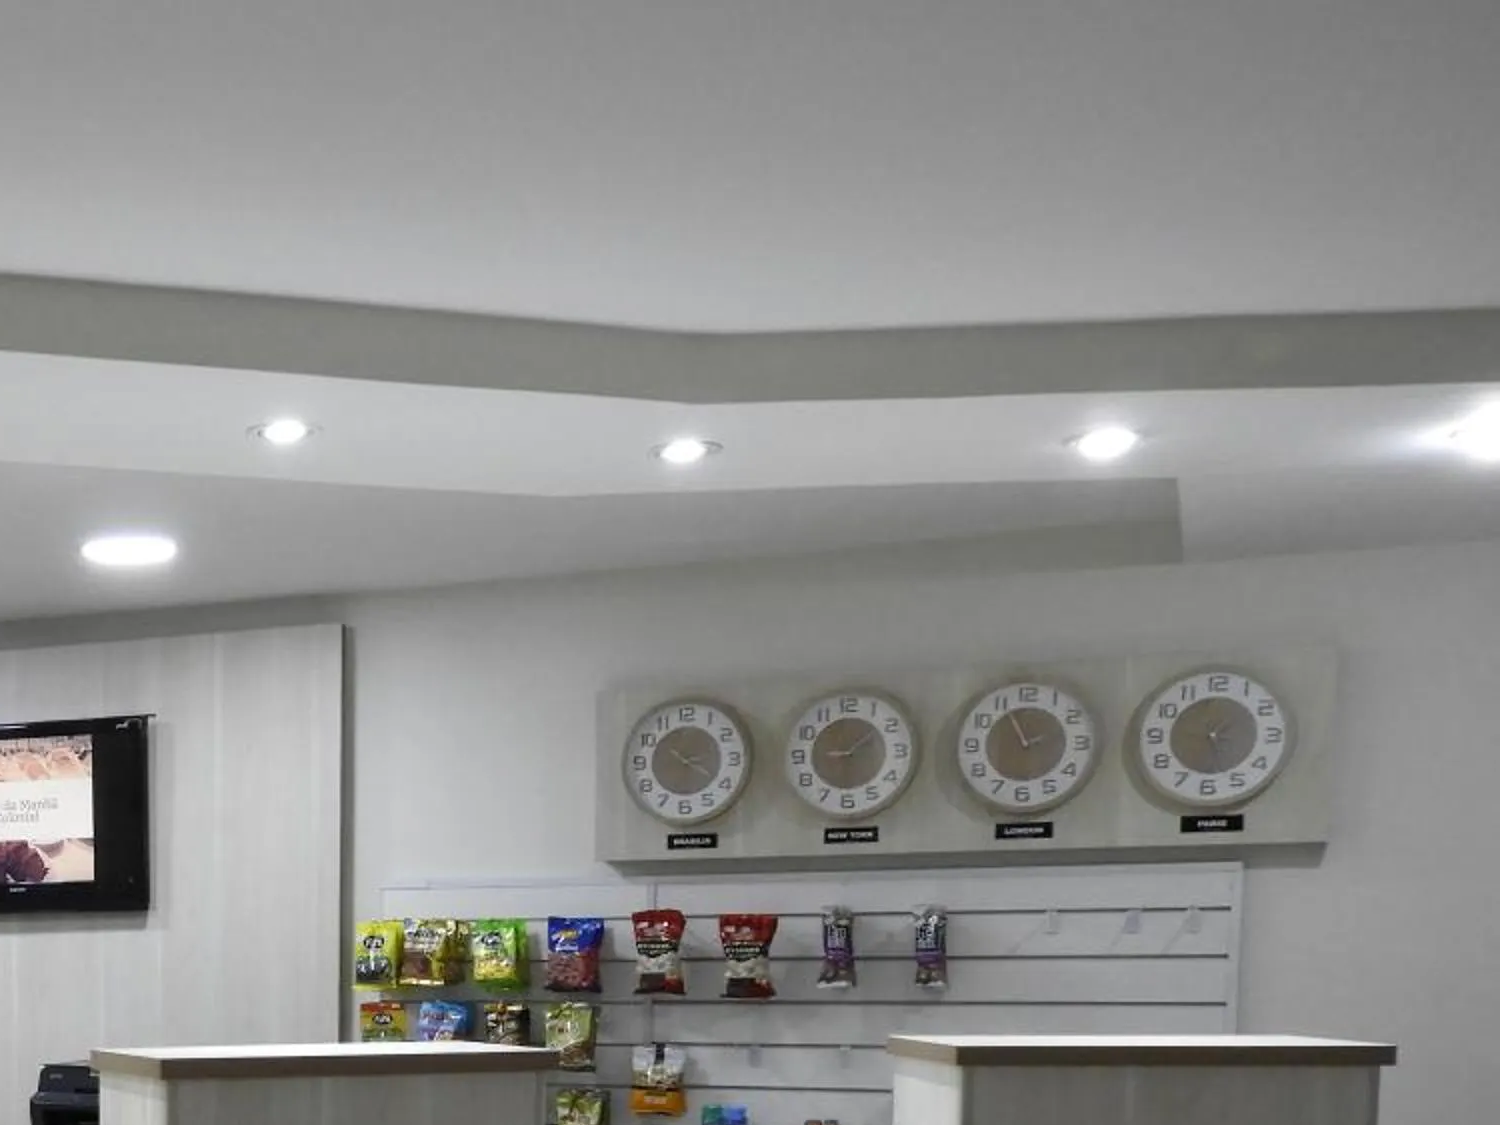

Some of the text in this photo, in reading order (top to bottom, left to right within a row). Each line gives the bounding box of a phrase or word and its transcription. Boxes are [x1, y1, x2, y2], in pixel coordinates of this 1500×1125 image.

[1208, 676, 1229, 692] 12
[1019, 687, 1038, 702] 12
[1181, 685, 1196, 700] 11
[840, 698, 859, 713] 12
[995, 697, 1007, 710] 11
[1159, 703, 1177, 718] 10
[1258, 700, 1274, 716] 2
[680, 707, 695, 722] 12
[818, 708, 829, 721] 11
[975, 713, 992, 728] 10
[1066, 709, 1080, 724] 2
[658, 716, 669, 730] 11
[884, 718, 898, 732] 2
[721, 727, 733, 742] 2
[800, 725, 815, 740] 10
[1147, 728, 1163, 744] 9
[1267, 727, 1282, 743] 3
[641, 733, 657, 747] 10
[964, 738, 978, 752] 9
[1073, 735, 1090, 750] 3
[791, 749, 805, 764] 9
[894, 743, 908, 759] 3
[633, 755, 646, 770] 9
[728, 751, 741, 766] 3
[1154, 754, 1169, 768] 8
[1252, 756, 1267, 770] 4
[884, 770, 897, 781] 4
[972, 763, 986, 777] 8
[1062, 762, 1076, 776] 4
[641, 779, 652, 792] 8
[718, 777, 732, 789] 4
[800, 773, 812, 786] 8
[1174, 772, 1188, 787] 7
[1229, 773, 1245, 787] 5
[866, 786, 879, 800] 5
[991, 780, 1004, 794] 7
[1015, 786, 1029, 802] 6
[1043, 780, 1056, 794] 5
[1200, 779, 1216, 795] 6
[658, 794, 669, 807] 7
[701, 793, 714, 806] 5
[820, 788, 830, 802] 7
[841, 794, 855, 808] 6
[678, 800, 692, 814] 6
